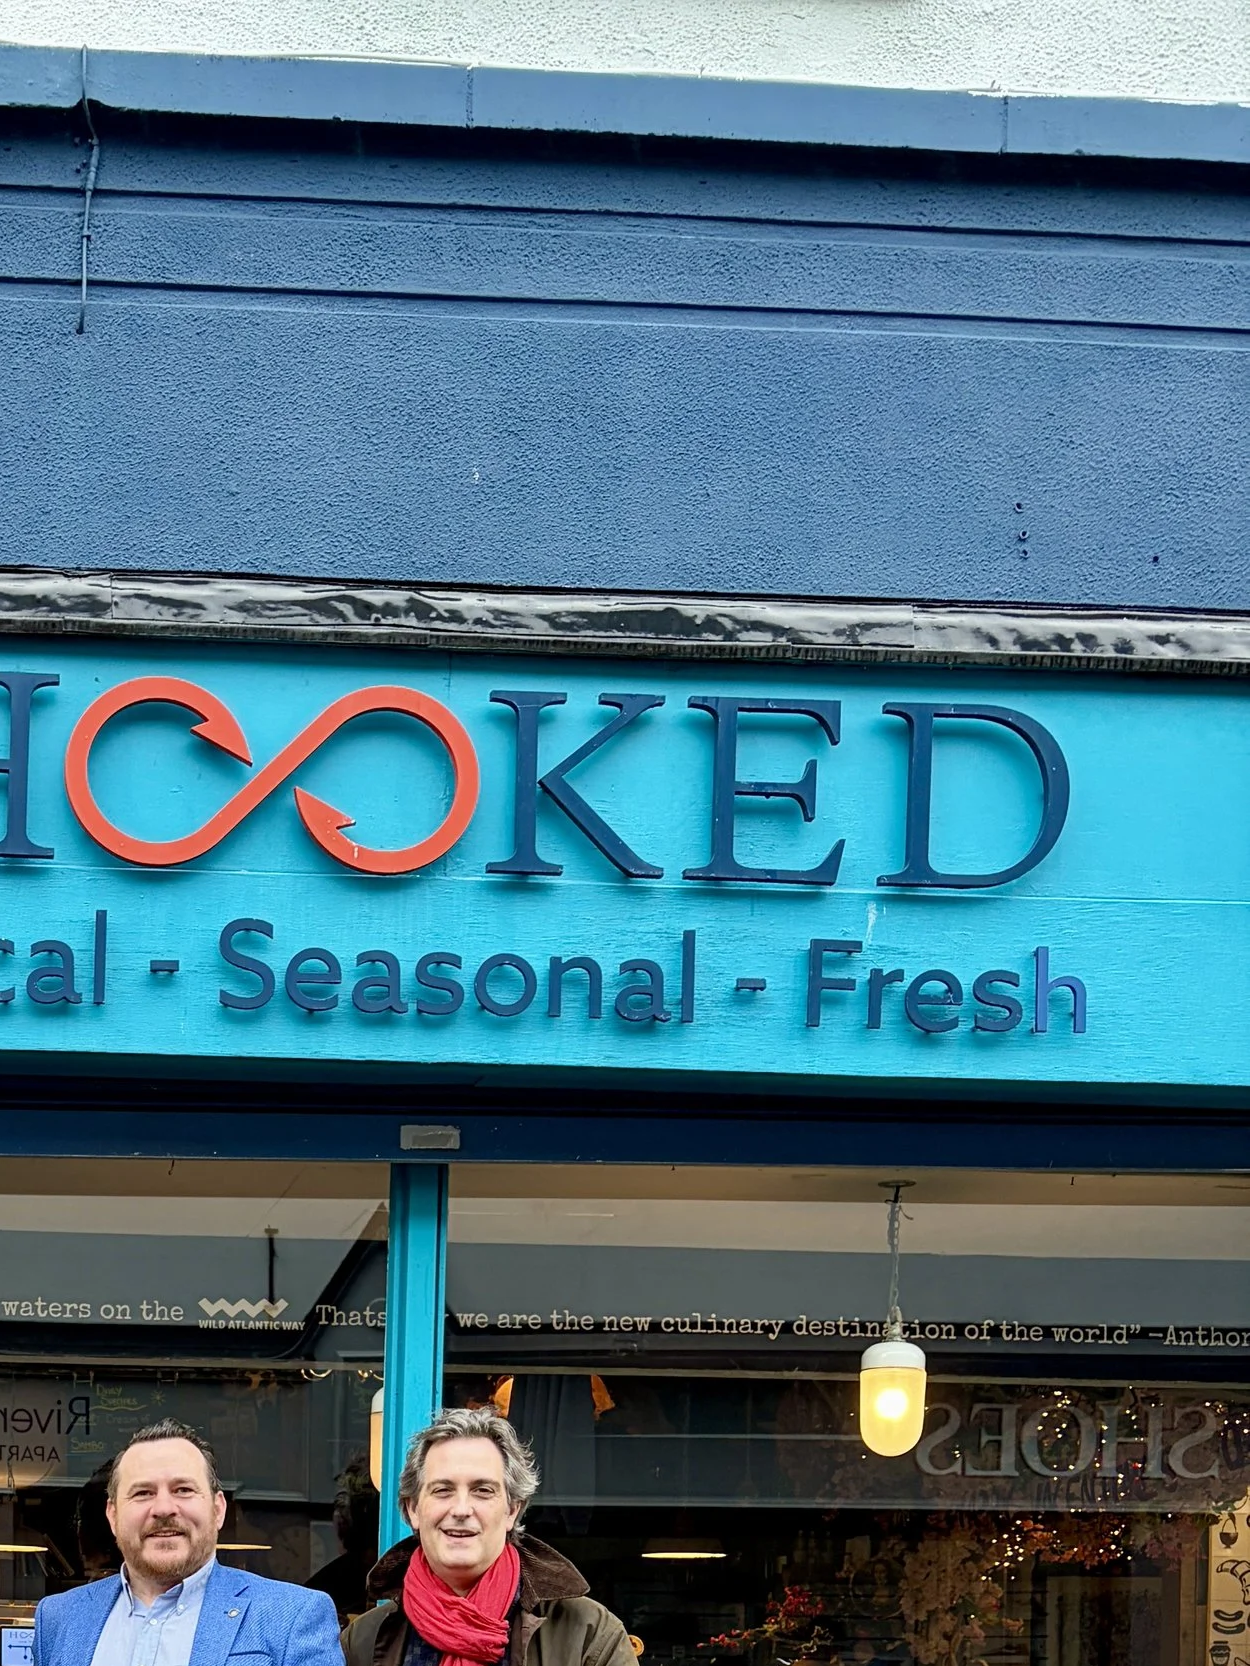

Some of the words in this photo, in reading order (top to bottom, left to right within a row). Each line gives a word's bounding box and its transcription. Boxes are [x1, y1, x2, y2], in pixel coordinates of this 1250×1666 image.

[218, 916, 697, 1026] Seasonal
[805, 937, 1089, 1036] Fresh
[2, 1296, 92, 1319] waters
[100, 1302, 132, 1320] on
[140, 1299, 184, 1321] the
[315, 1304, 387, 1328] Thats
[198, 1319, 225, 1329] WILD
[228, 1319, 280, 1331] ATLANTIC
[282, 1320, 306, 1332] WAY
[456, 1313, 489, 1330] we
[497, 1313, 542, 1330] are
[550, 1310, 595, 1331] the
[603, 1314, 653, 1333] new
[661, 1313, 786, 1341] culinary
[964, 1318, 994, 1340] of
[999, 1320, 1043, 1342] the
